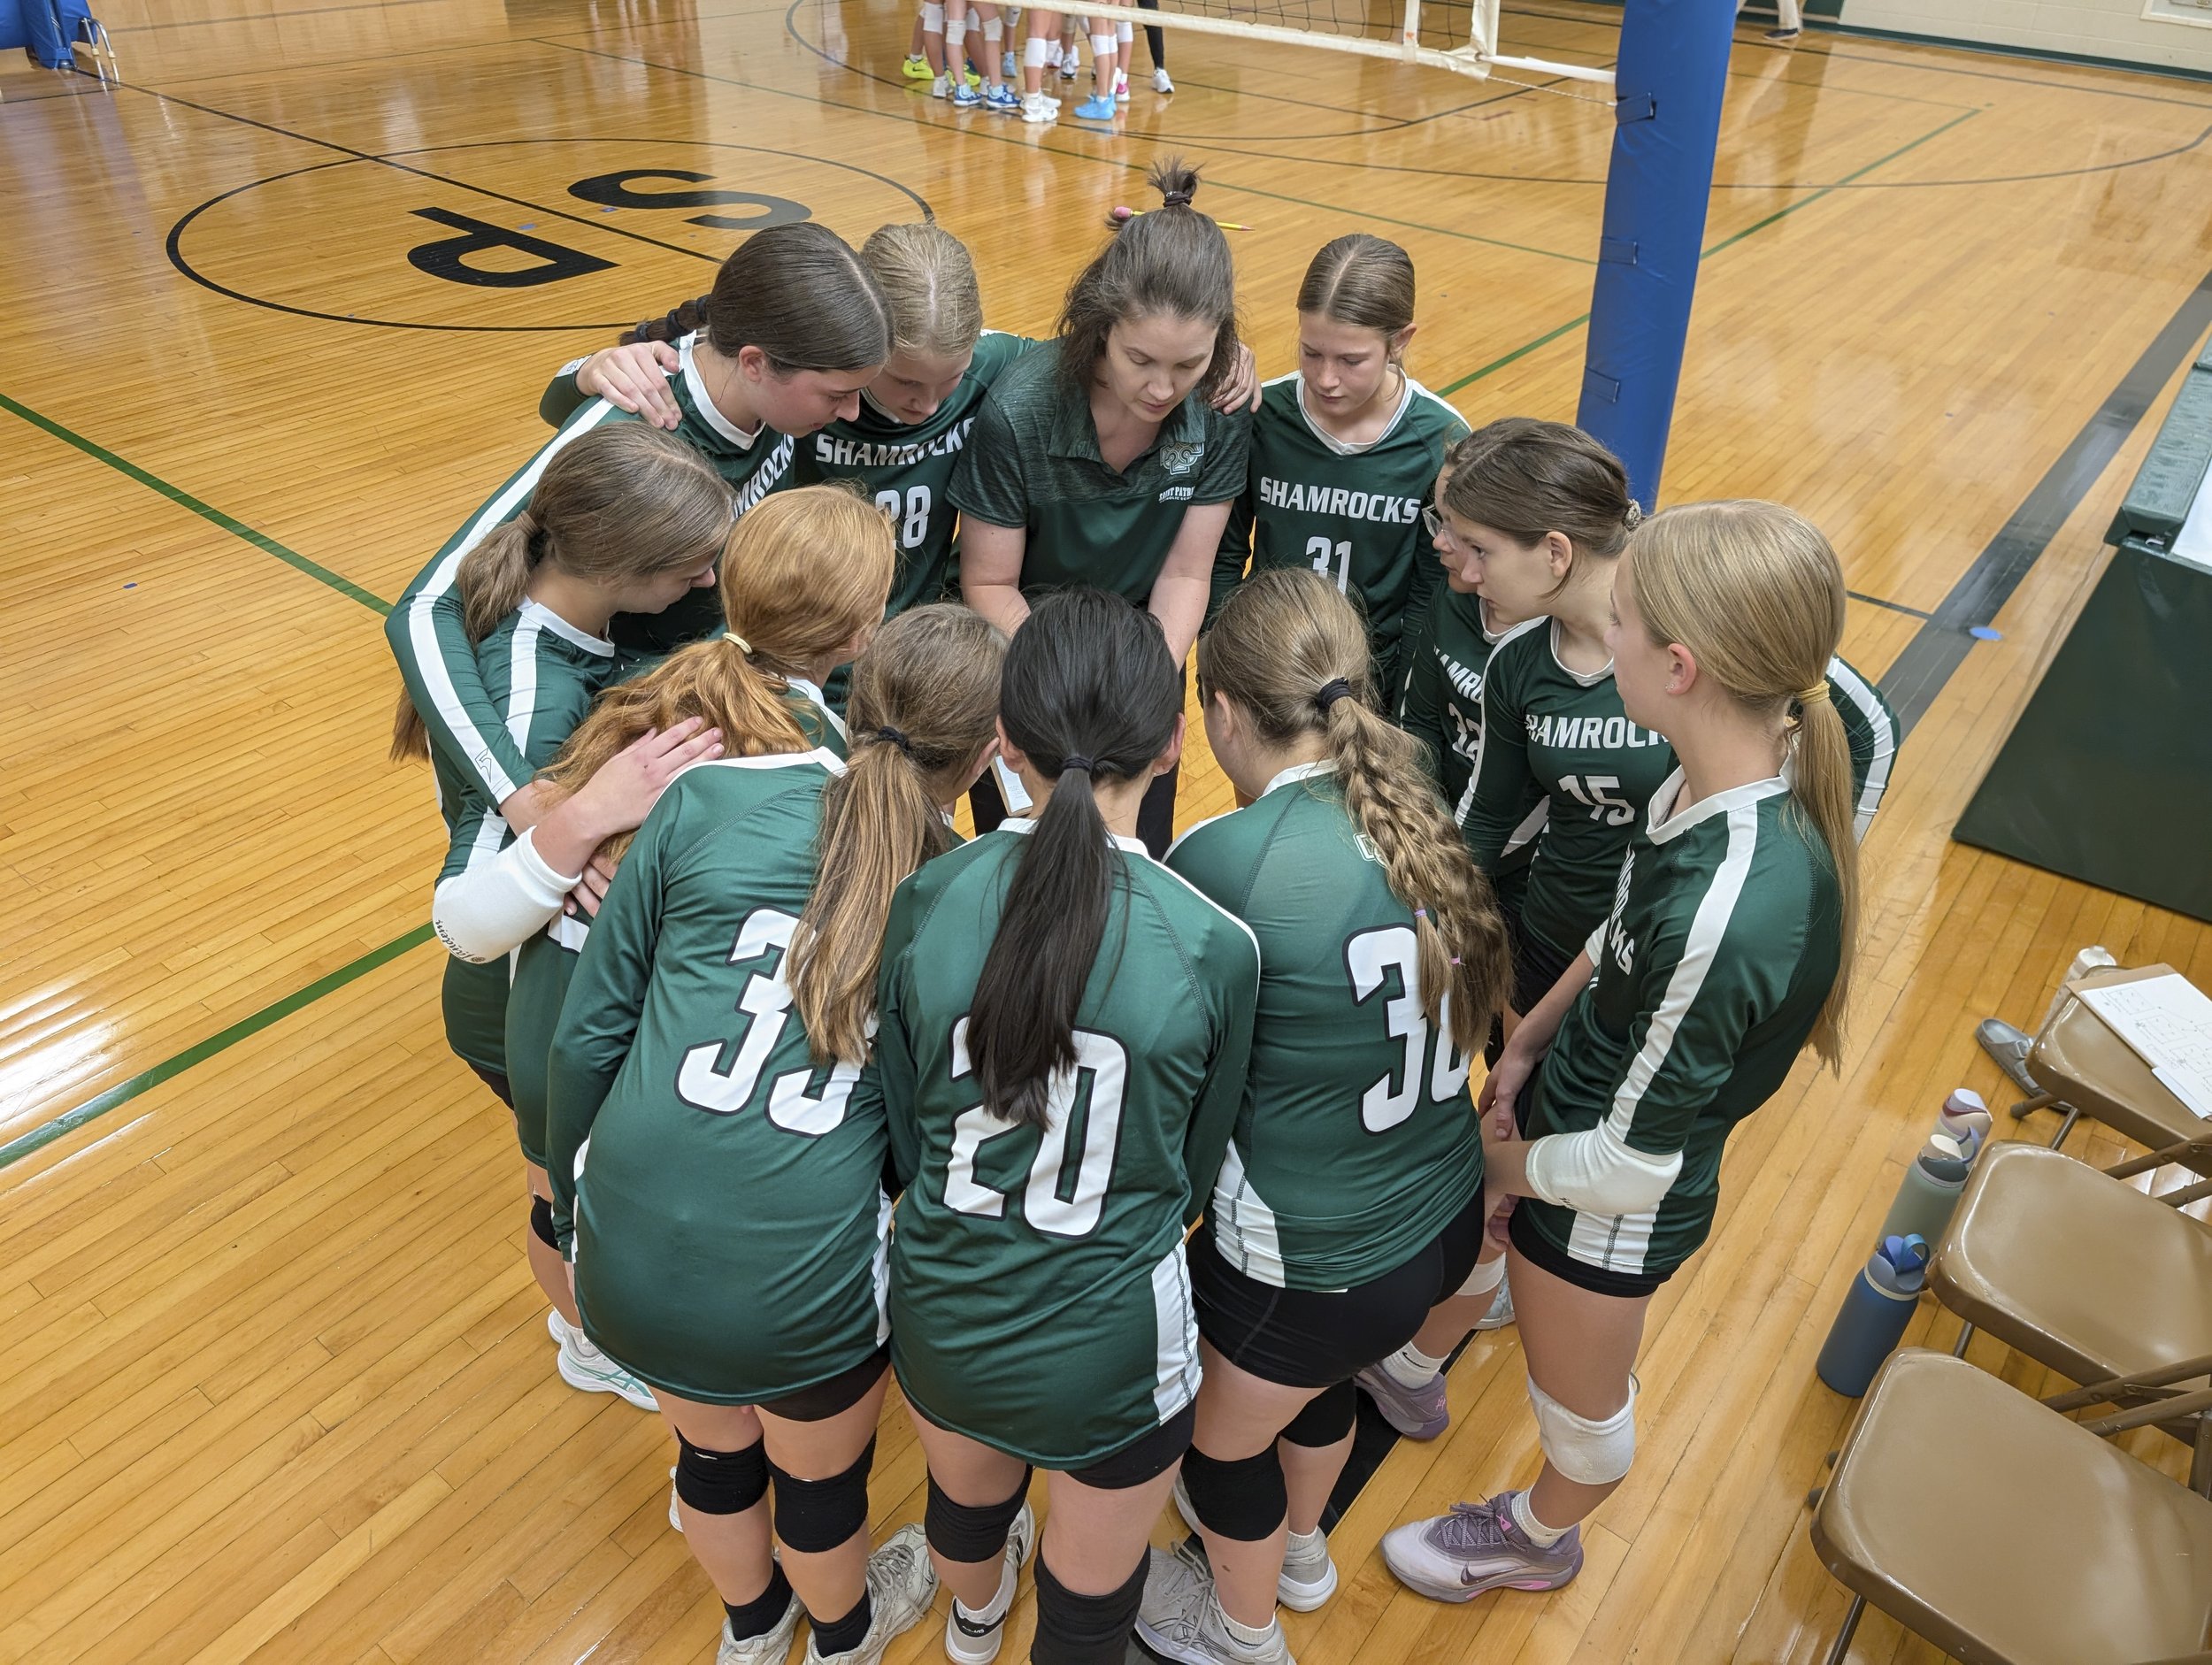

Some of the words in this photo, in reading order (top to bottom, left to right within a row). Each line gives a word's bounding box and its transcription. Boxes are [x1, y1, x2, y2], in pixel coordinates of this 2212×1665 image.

[407, 206, 622, 288] P
[1260, 476, 1421, 525] SHAMROCKS
[1305, 536, 1352, 595] 31
[1557, 775, 1636, 826] 15
[941, 1011, 1132, 1241] 20
